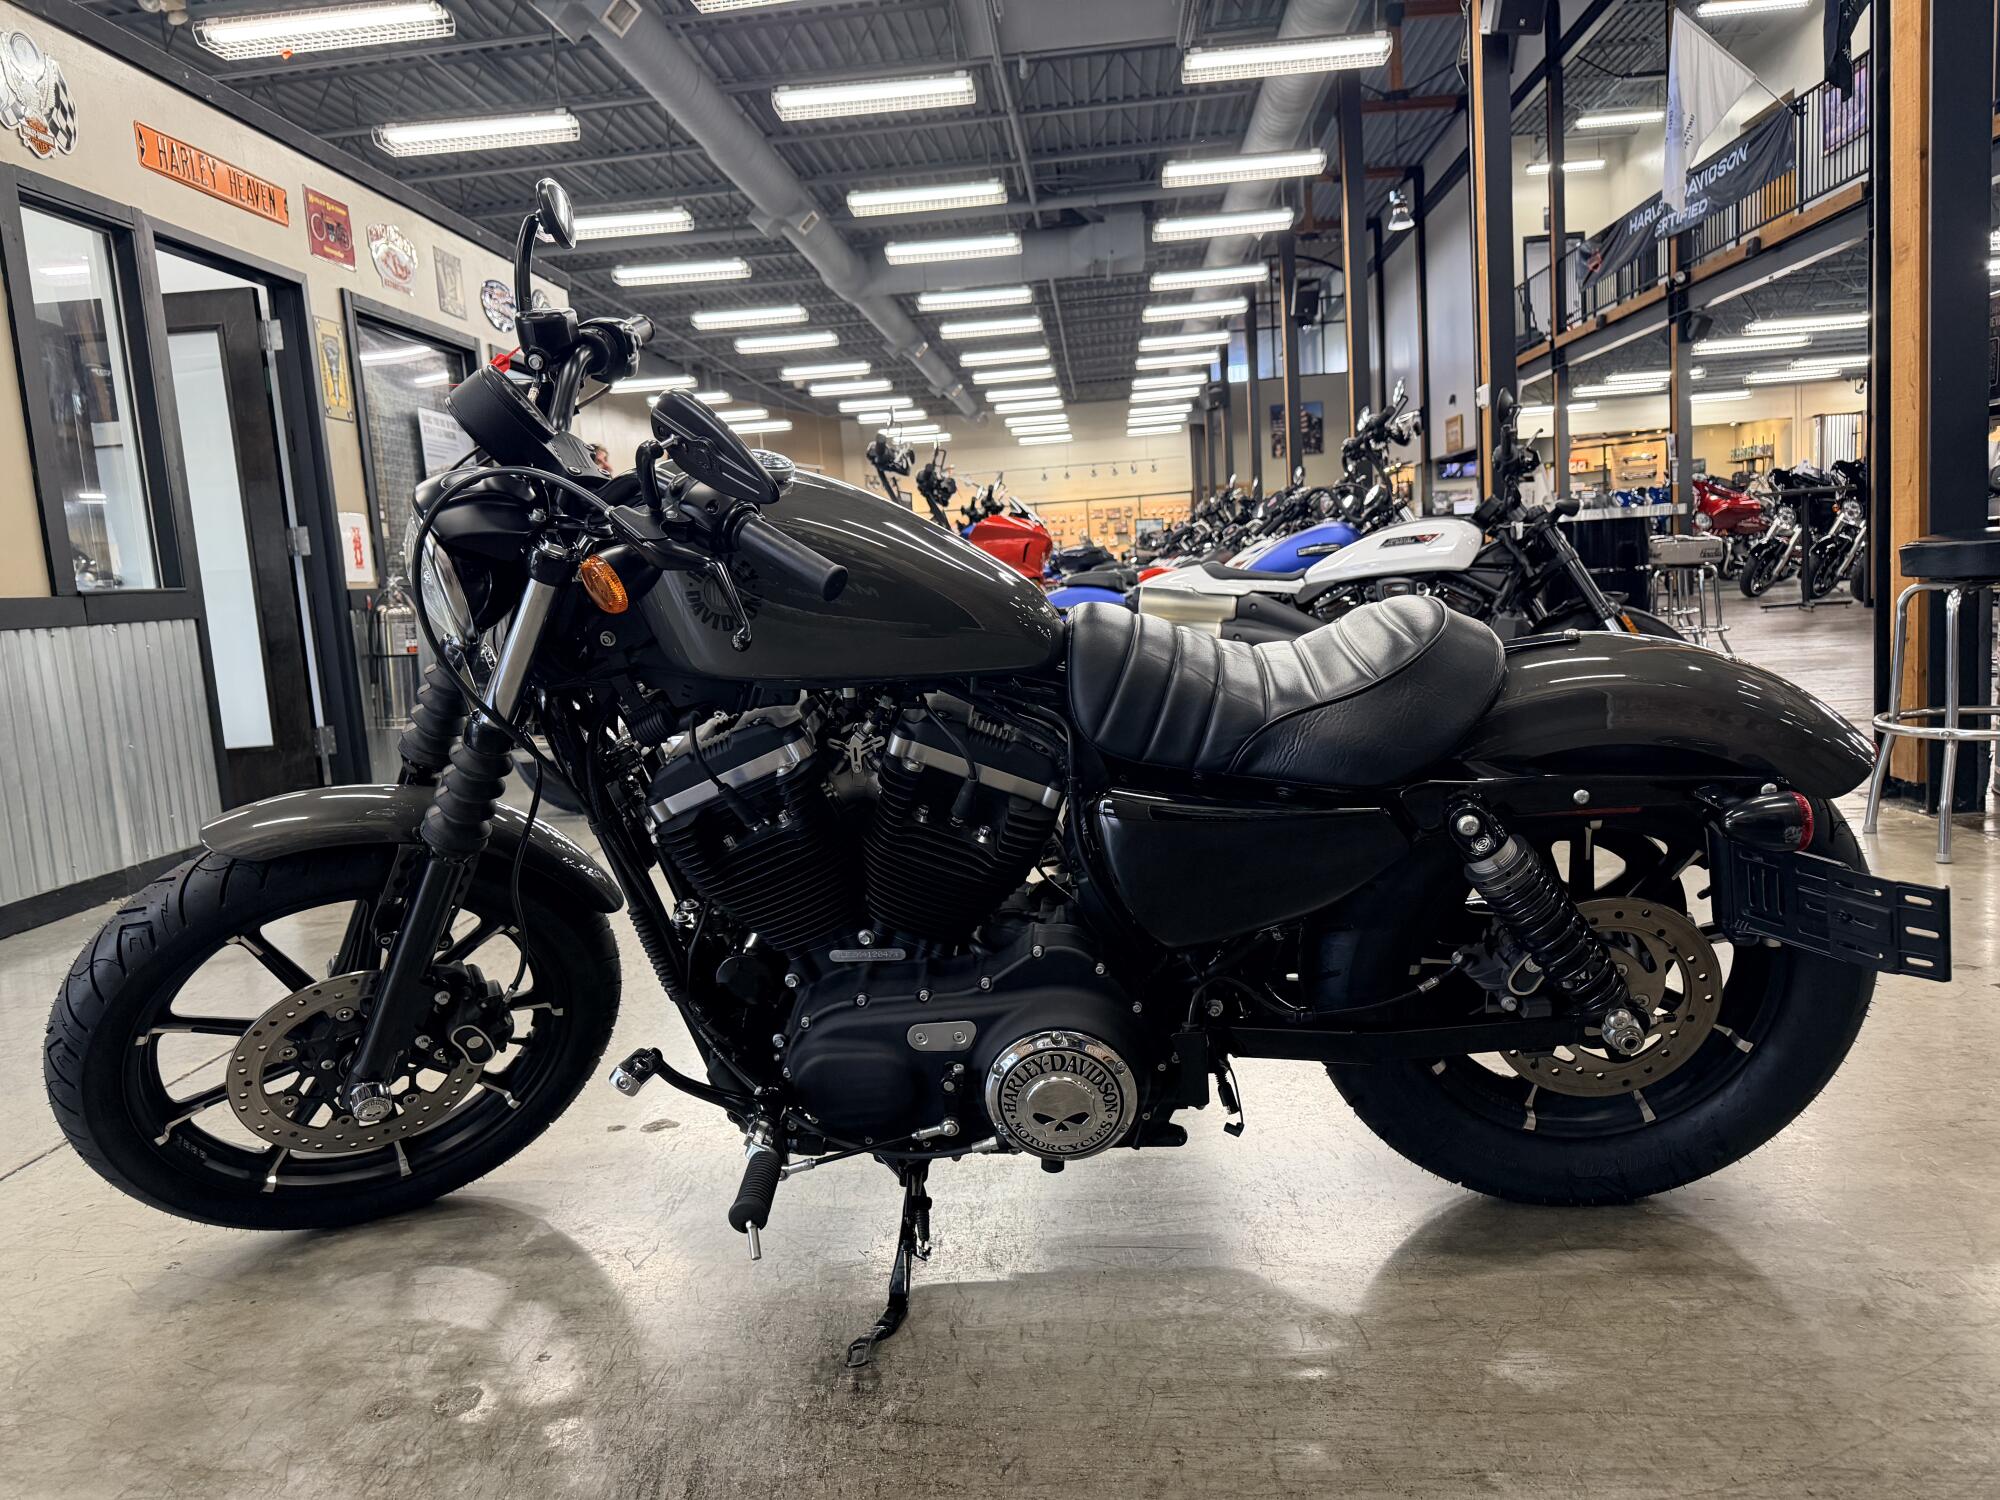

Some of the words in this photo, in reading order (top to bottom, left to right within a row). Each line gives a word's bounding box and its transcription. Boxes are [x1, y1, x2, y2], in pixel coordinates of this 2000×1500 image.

[156, 135, 217, 191] HARLEY
[226, 166, 278, 217] HEAVEN
[1003, 1053, 1118, 1114] HARLEY-DAVIDSON
[1011, 1120, 1114, 1151] MOTORCYCLES
